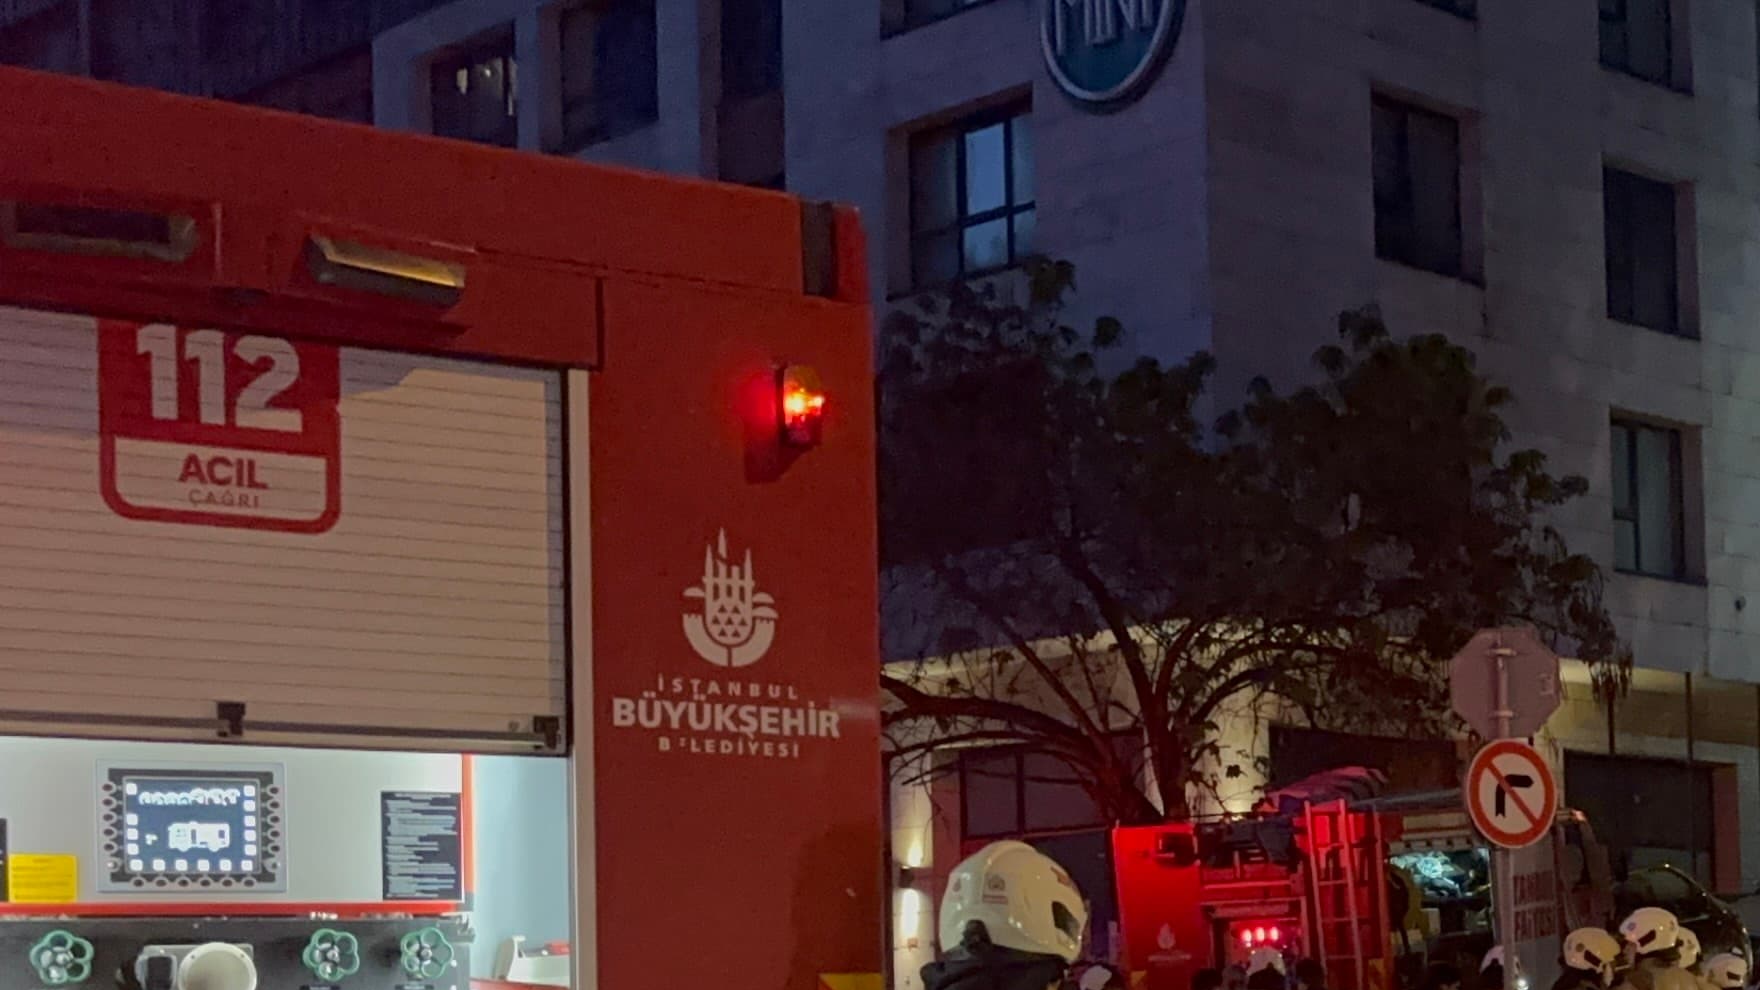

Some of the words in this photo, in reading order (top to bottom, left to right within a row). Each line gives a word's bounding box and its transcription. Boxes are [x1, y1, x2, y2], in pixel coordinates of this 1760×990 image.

[137, 323, 303, 432] 112
[187, 489, 260, 508] ÇAĞRI
[657, 674, 799, 701] İSTANBUL
[612, 691, 840, 739] BÜYÜKŞEHİR
